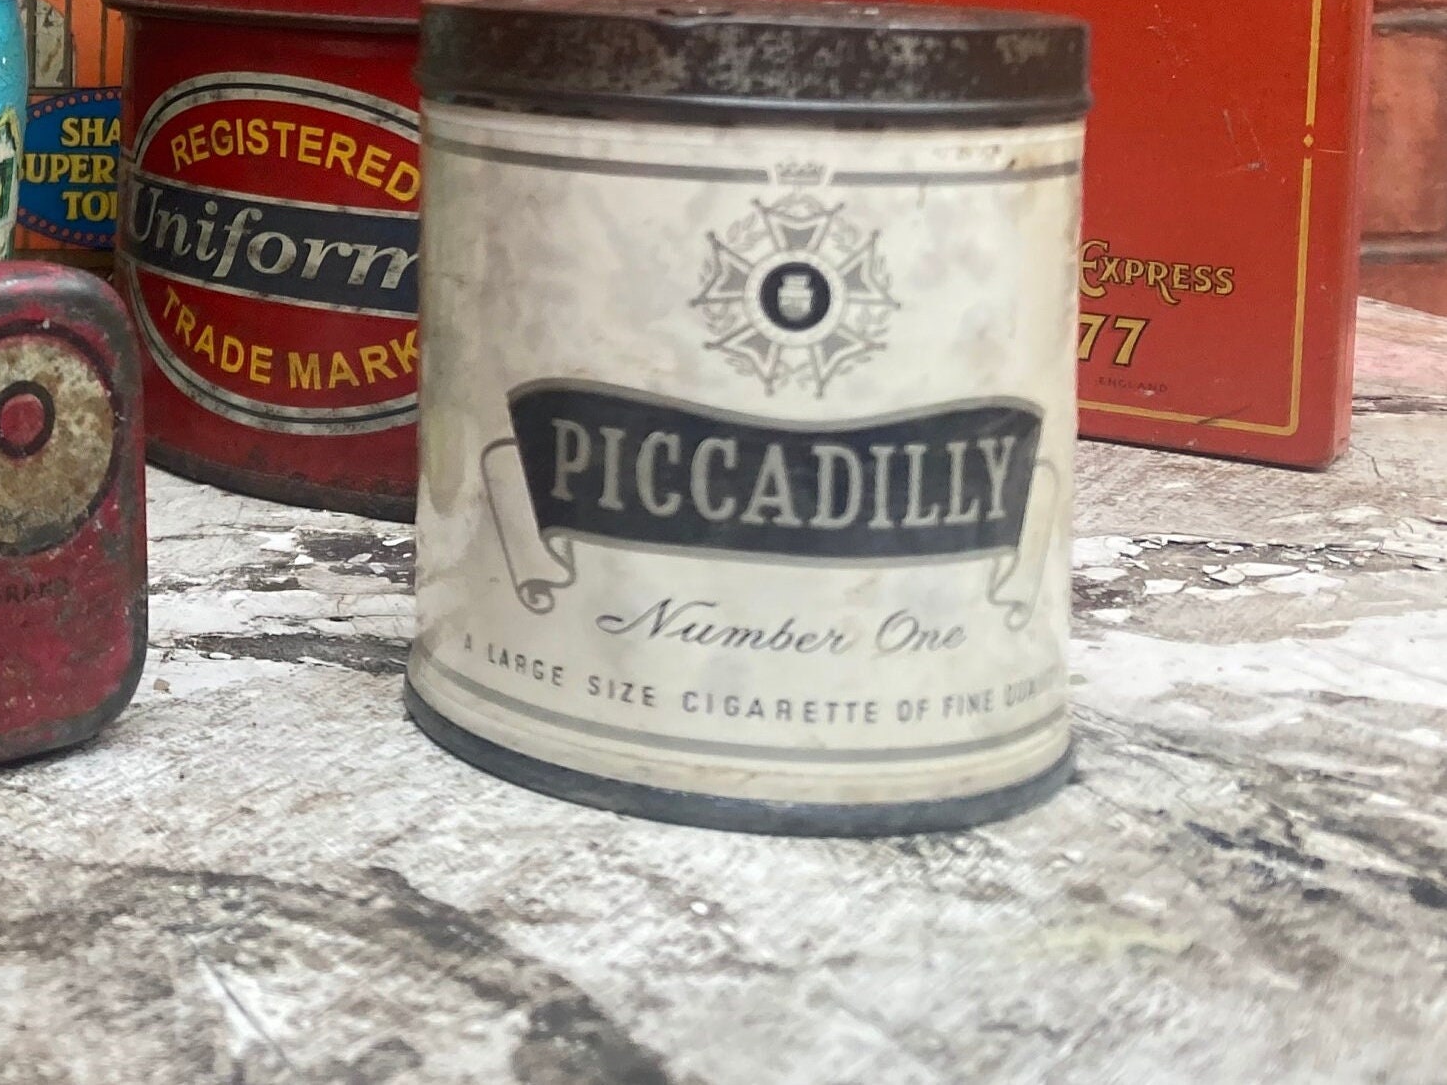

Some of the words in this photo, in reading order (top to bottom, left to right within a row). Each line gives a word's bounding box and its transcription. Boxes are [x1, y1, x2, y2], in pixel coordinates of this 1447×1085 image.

[170, 118, 419, 203] REGISTERED
[163, 284, 272, 384] TRADE
[288, 327, 419, 391] MARK
[1098, 376, 1169, 394] ENGLAND
[552, 418, 1016, 531] PICCADILLY
[595, 598, 853, 655] Number
[874, 608, 967, 659] One
[463, 633, 473, 652] A
[487, 642, 565, 687] LARGE
[587, 675, 658, 708] SIZE
[681, 690, 877, 724] CIGARETTE
[896, 699, 929, 722] OF
[943, 689, 993, 718] FINE
